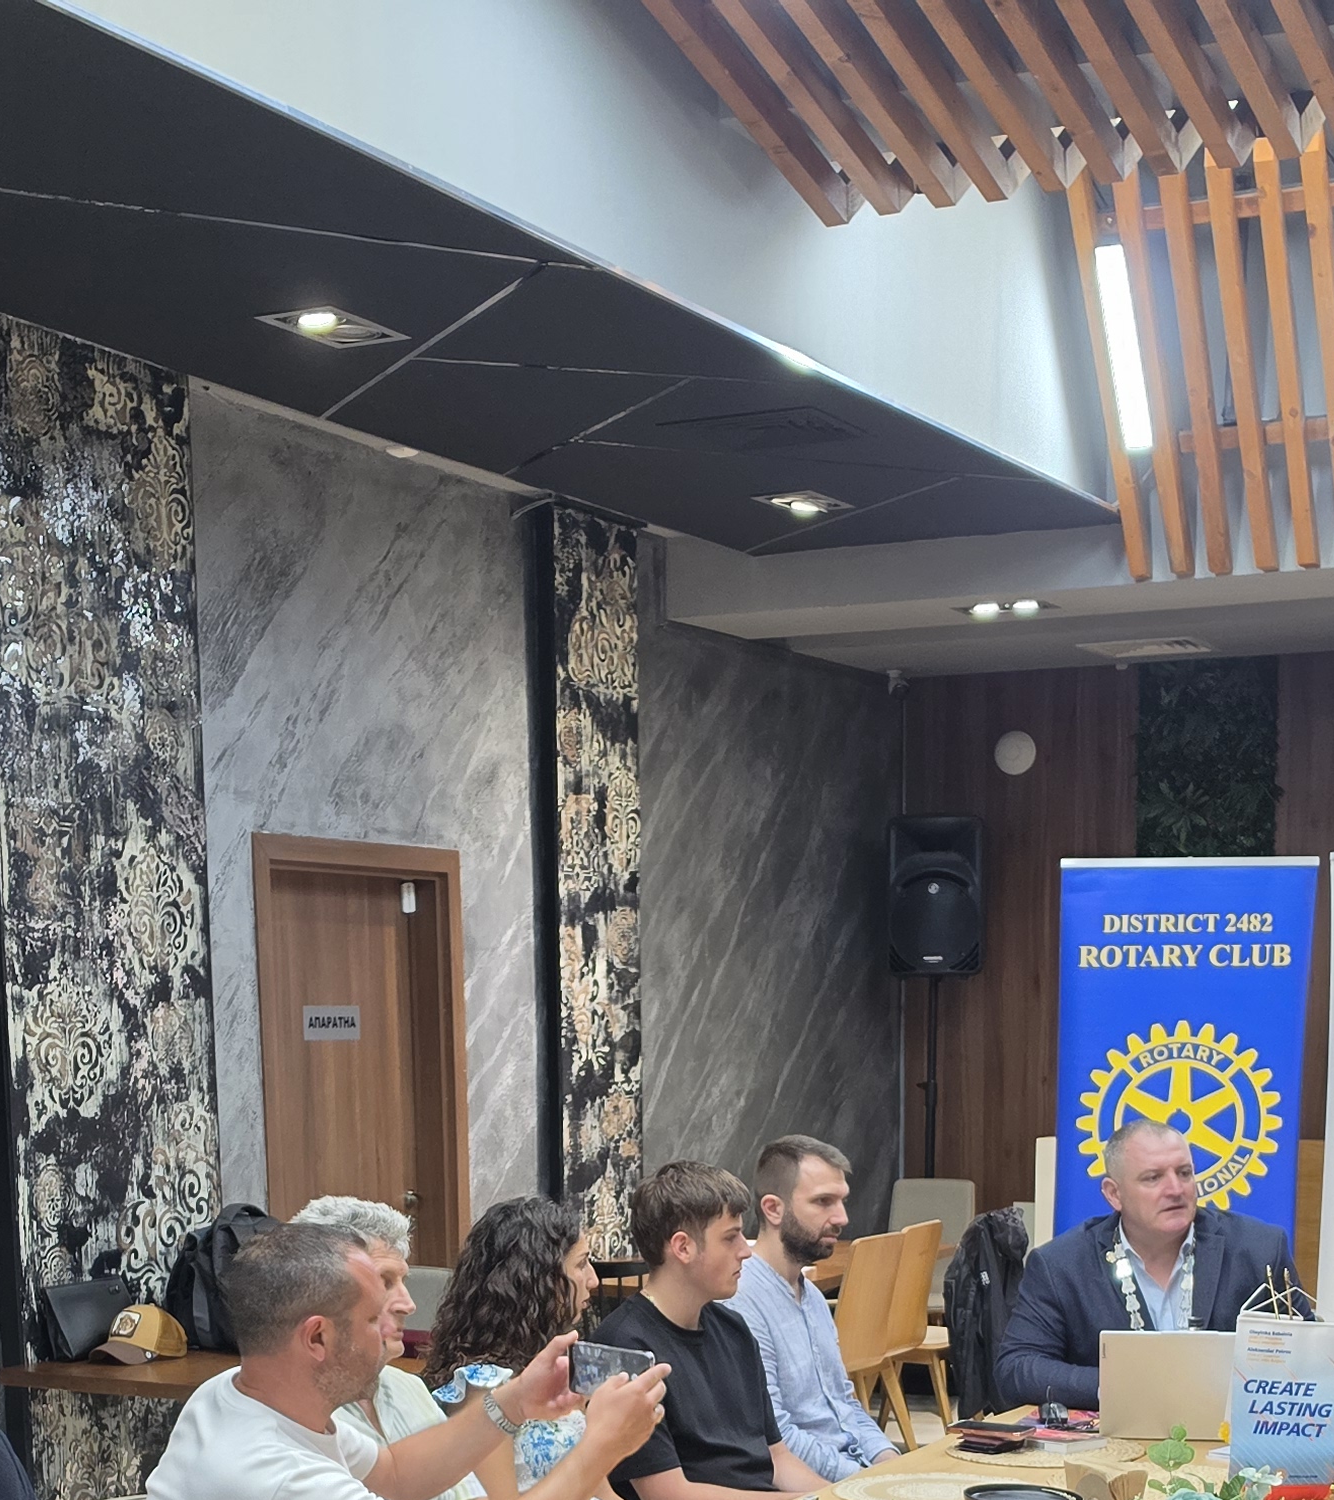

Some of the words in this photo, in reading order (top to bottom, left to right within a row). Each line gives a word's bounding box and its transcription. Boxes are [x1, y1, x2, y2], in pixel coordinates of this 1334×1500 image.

[1102, 914, 1219, 933] DISTRICT
[1225, 913, 1273, 933] 2482
[1078, 945, 1203, 968] ROTARY
[1209, 944, 1292, 967] CLUB
[308, 1016, 356, 1029] АПАРАТНА
[1139, 1042, 1226, 1069] ROTARY
[1197, 1153, 1251, 1197] IONAL
[1243, 1379, 1317, 1397] CREATE
[1248, 1400, 1333, 1418] LASTING
[1252, 1420, 1327, 1438] IMPACT
